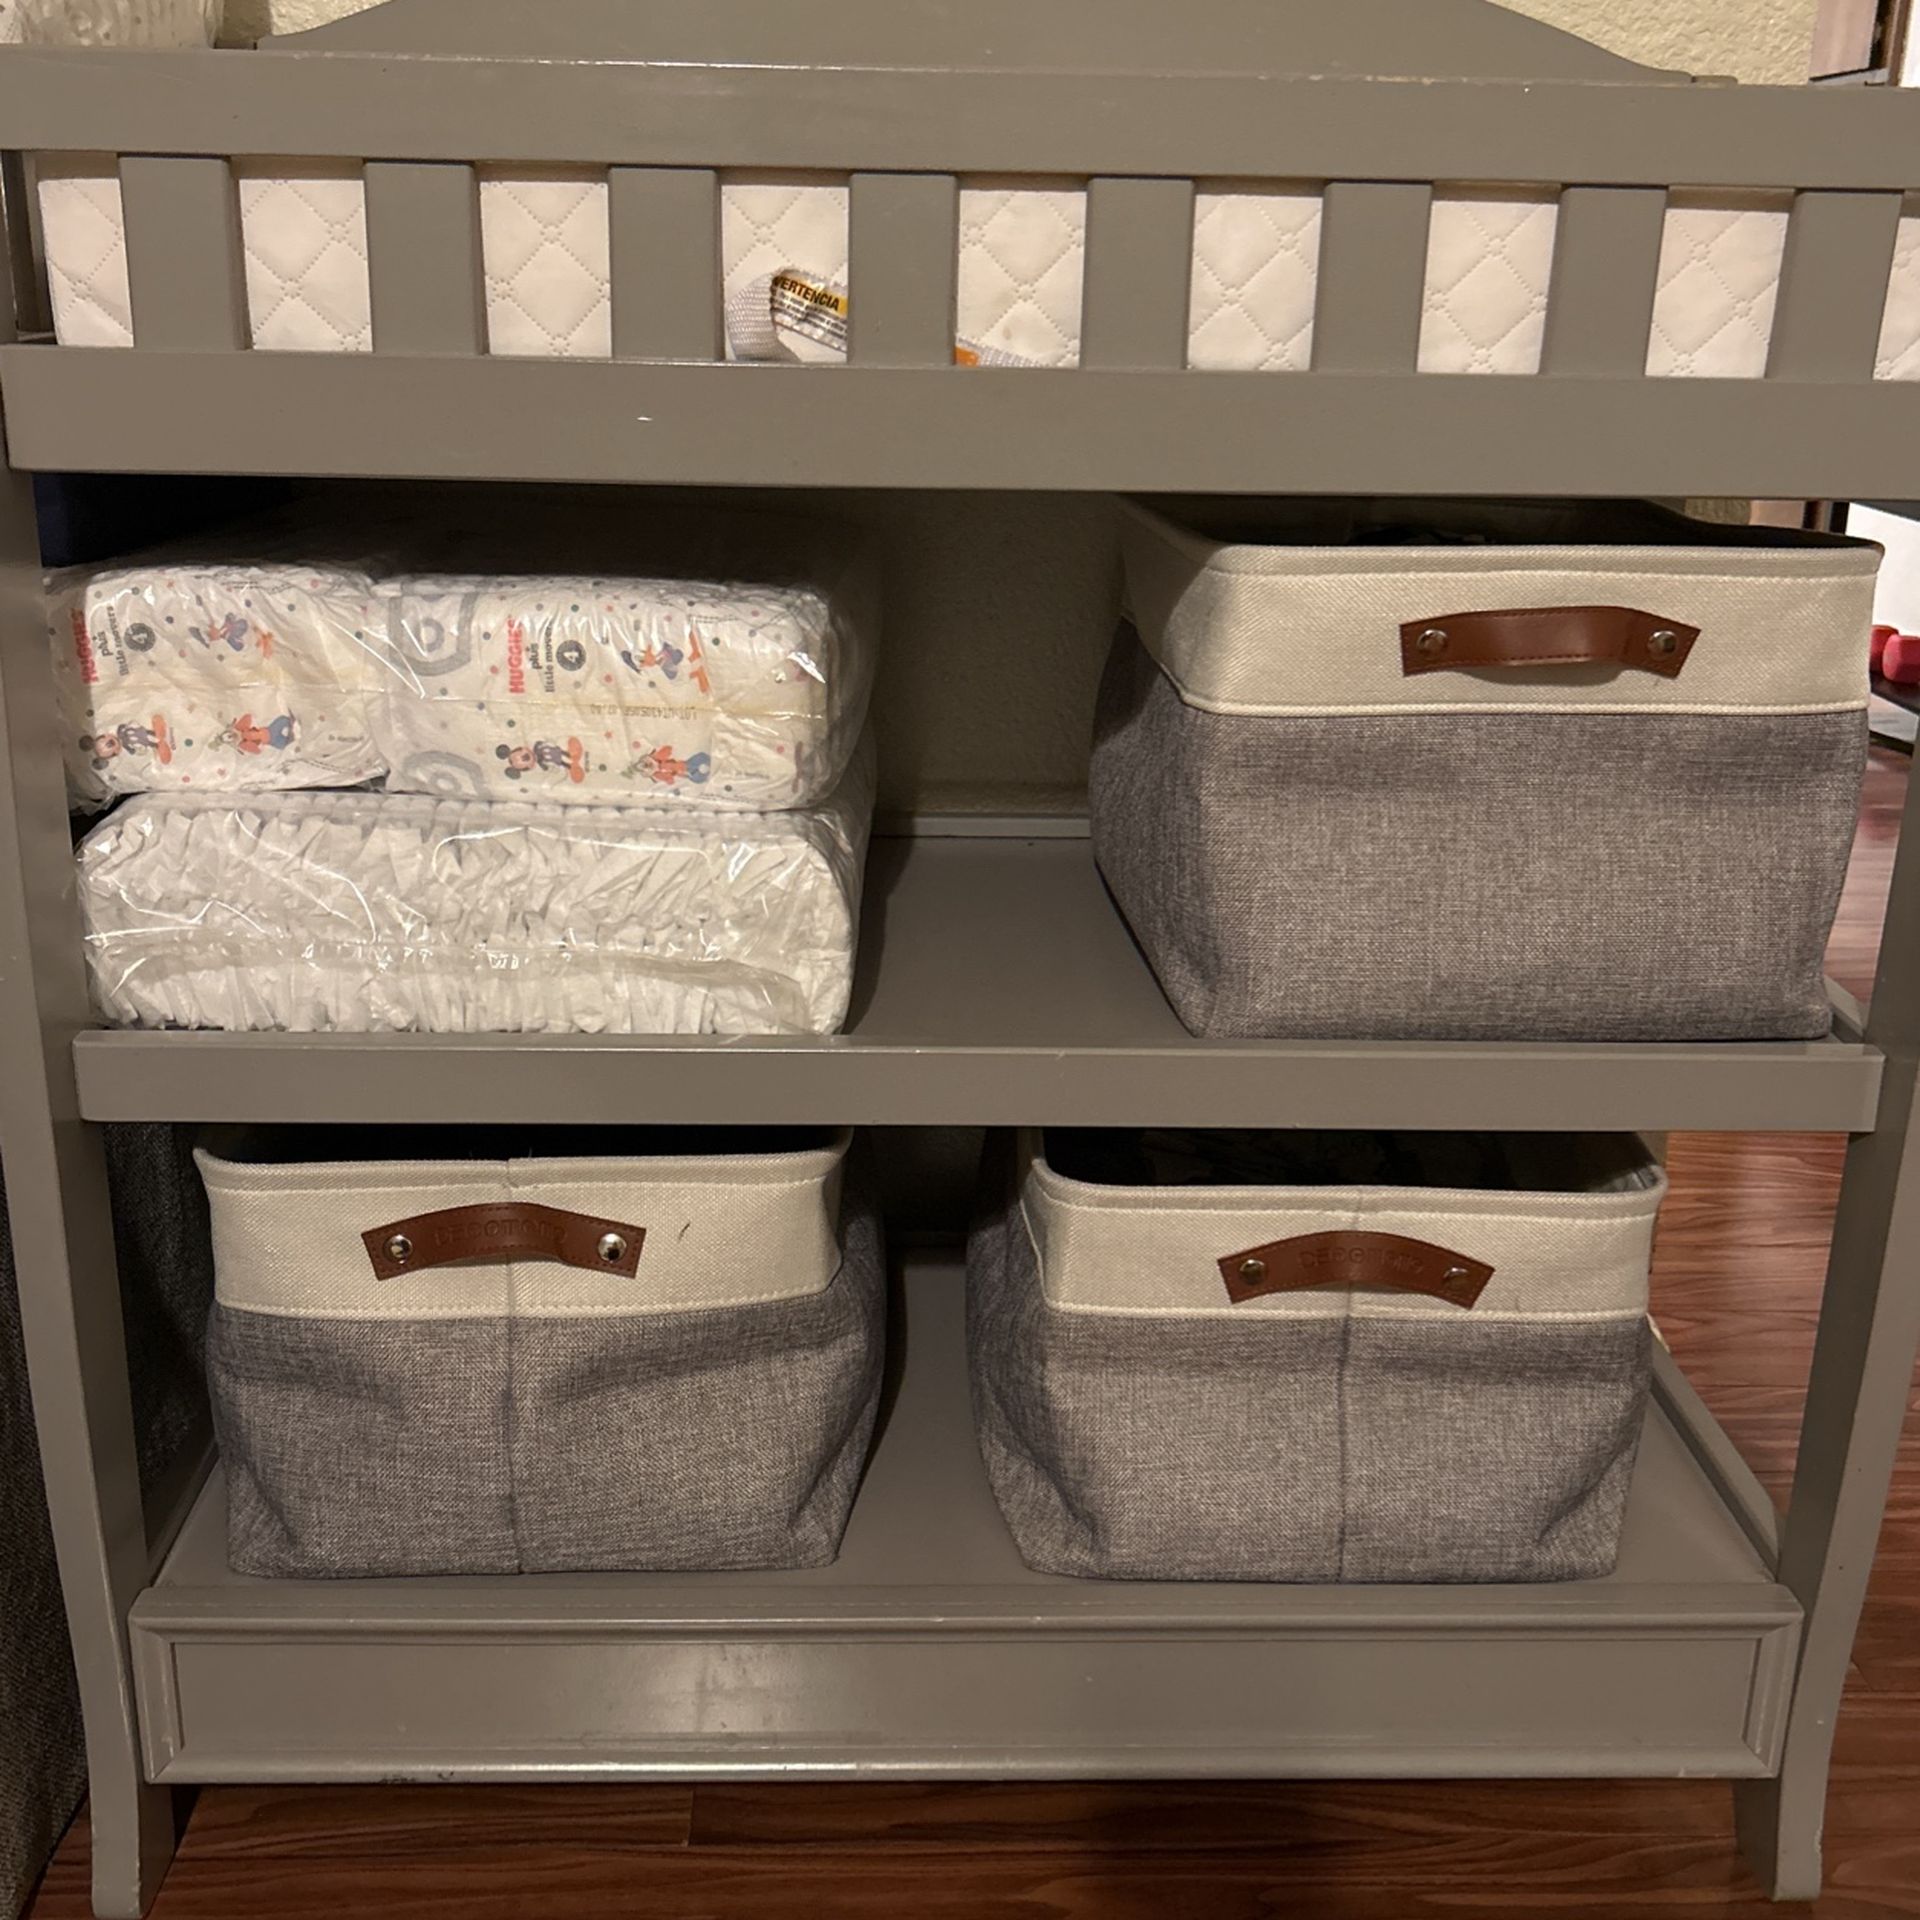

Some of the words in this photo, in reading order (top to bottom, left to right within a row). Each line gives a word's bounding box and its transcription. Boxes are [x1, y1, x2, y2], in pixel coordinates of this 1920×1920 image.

[508, 618, 525, 693] HUGGIES
[528, 643, 543, 669] plus
[544, 664, 556, 693] little
